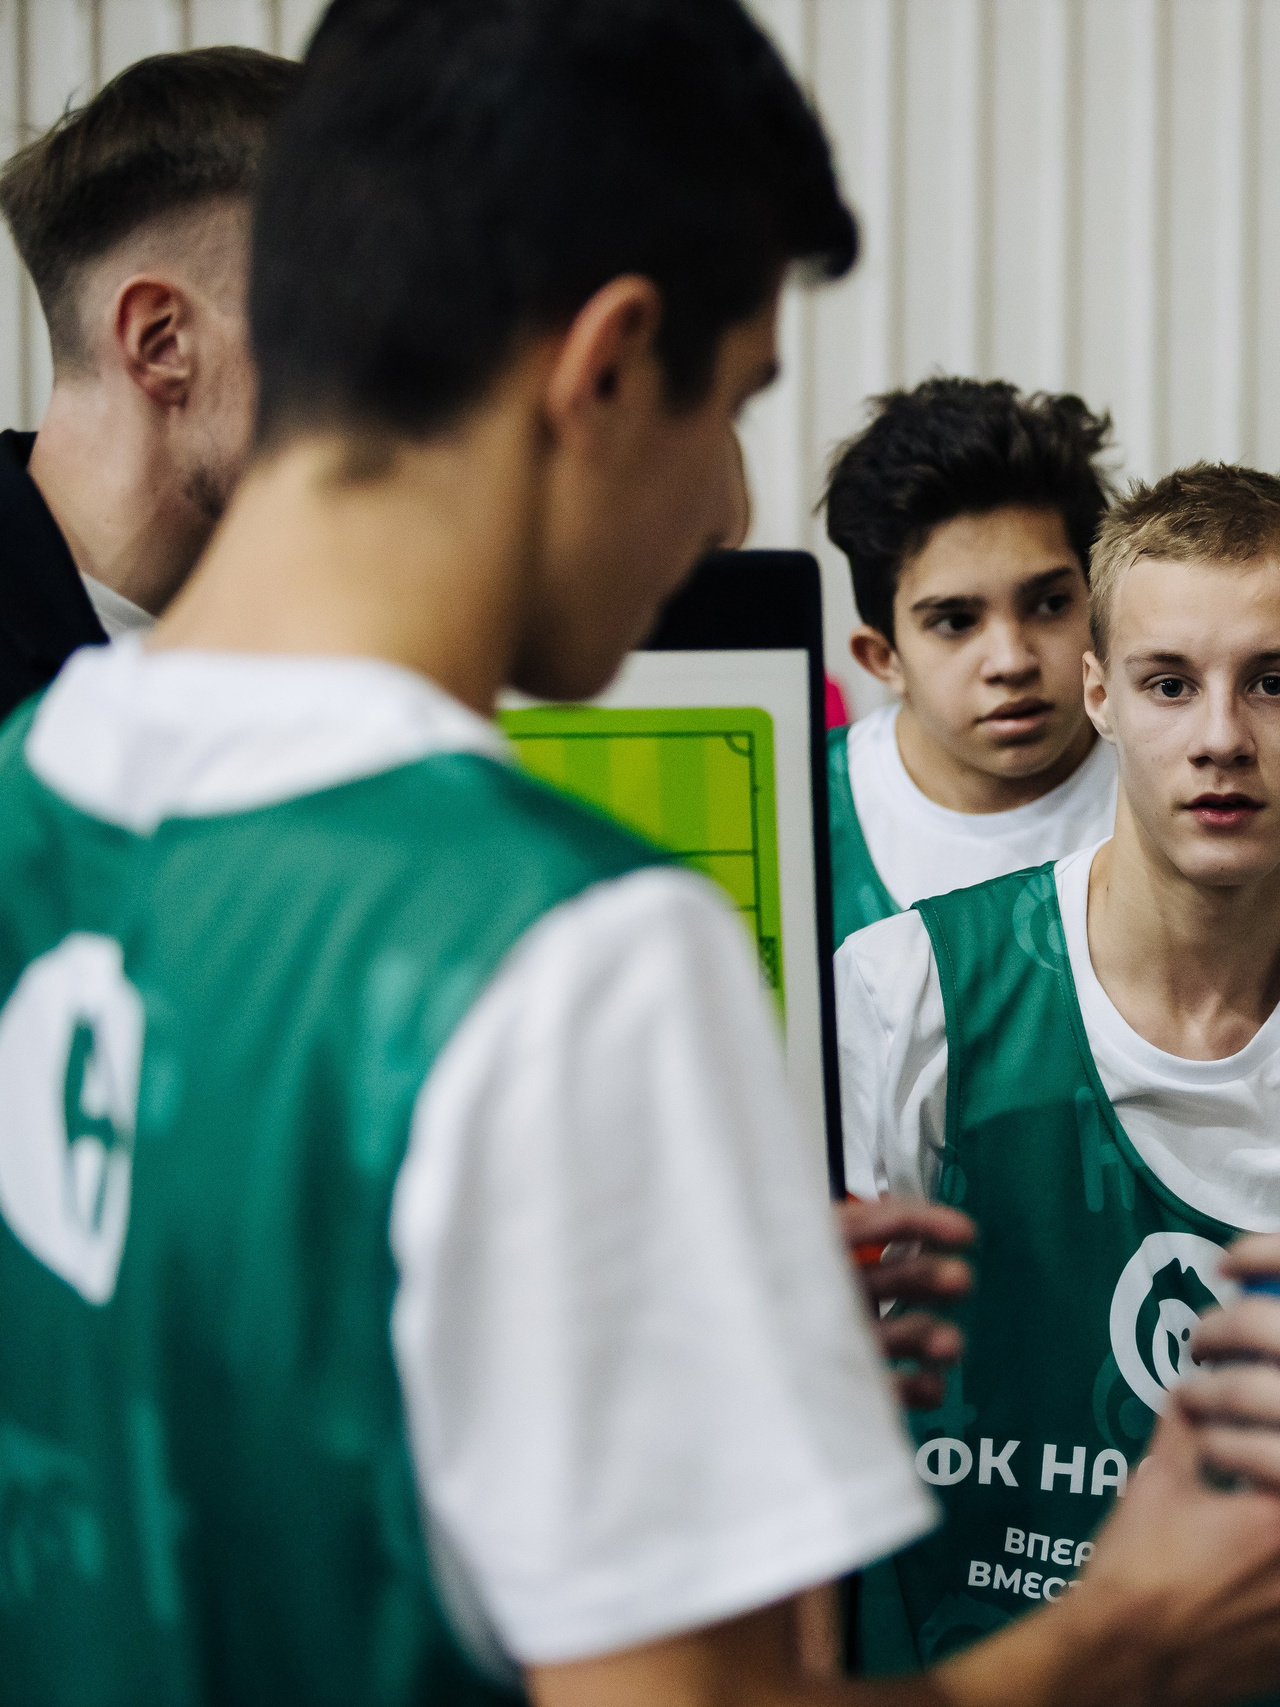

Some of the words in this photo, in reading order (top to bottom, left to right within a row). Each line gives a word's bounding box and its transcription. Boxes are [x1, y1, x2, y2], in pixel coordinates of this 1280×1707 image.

[915, 1437, 1021, 1488] ФК
[1040, 1443, 1128, 1498] НА
[1004, 1526, 1098, 1567] ВПЕР
[967, 1560, 1083, 1604] ВМЕС
